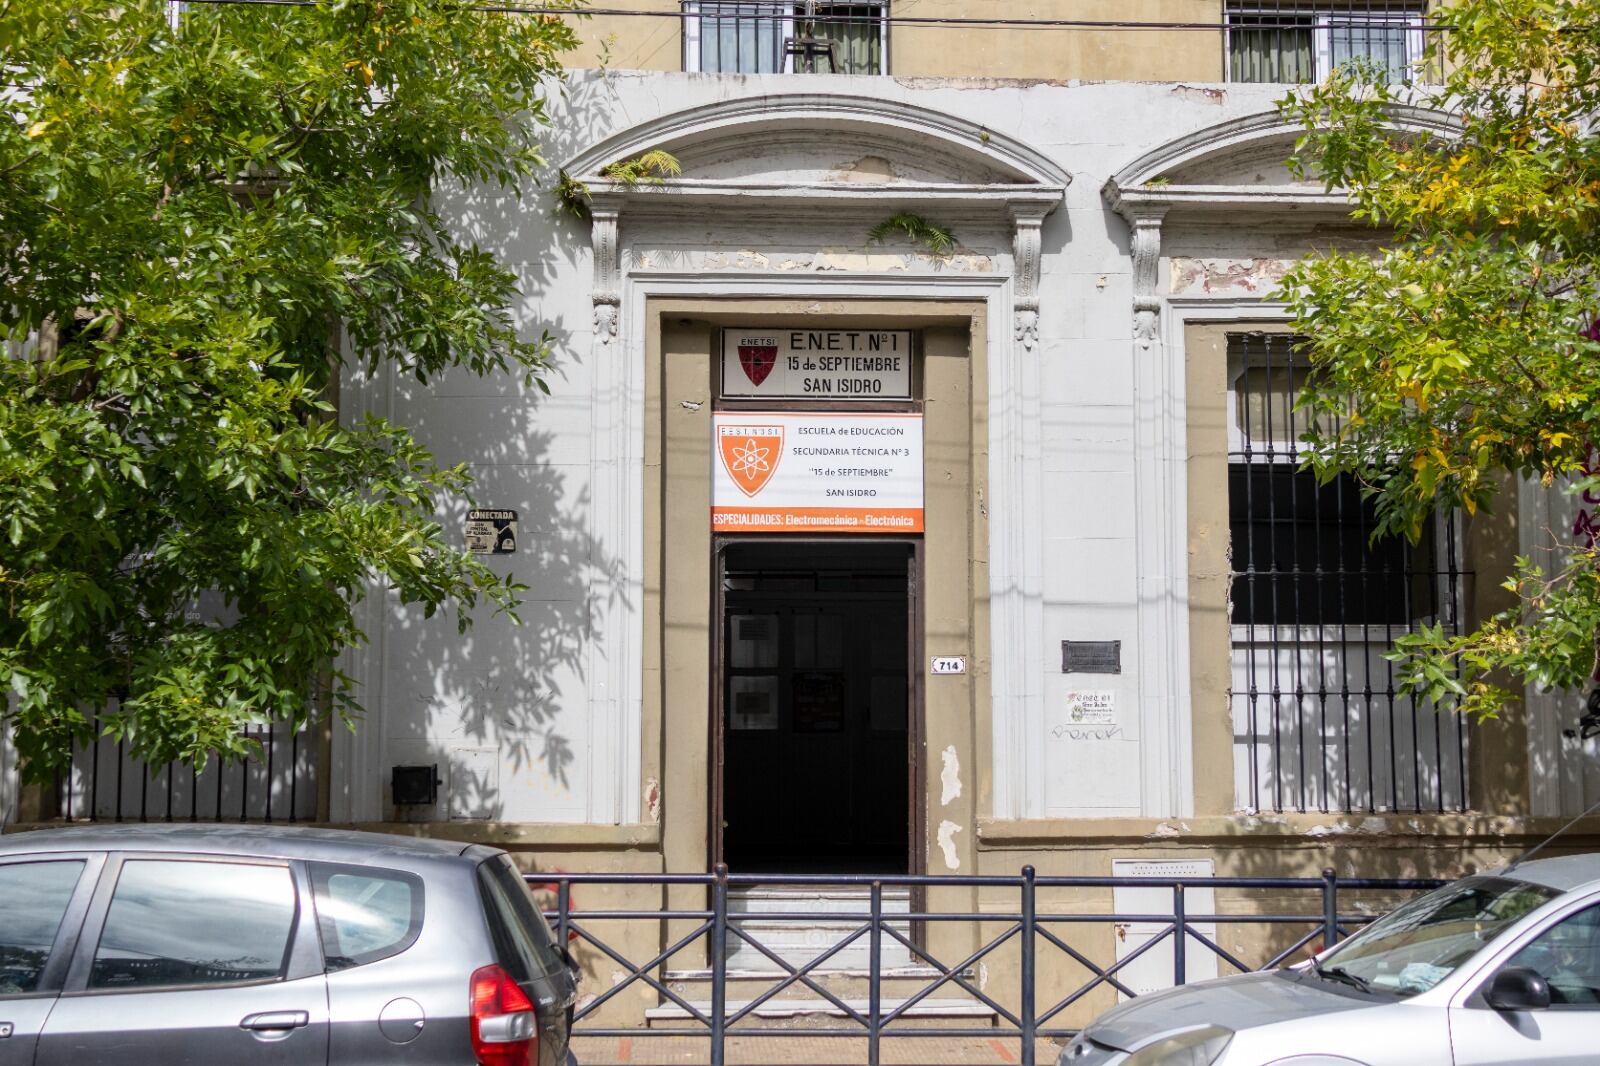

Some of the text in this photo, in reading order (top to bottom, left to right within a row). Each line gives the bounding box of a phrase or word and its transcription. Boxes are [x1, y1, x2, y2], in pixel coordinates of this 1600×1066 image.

[787, 356, 901, 372] 15 de SEPTIEMBRE
[803, 378, 882, 394] SAN ISIDRO
[798, 426, 904, 436] ESCUELA de EDUCACIÓN
[792, 447, 849, 456] SECUNDARIA
[851, 446, 889, 456] TÉCNICA
[904, 448, 910, 457] 3
[825, 467, 836, 476] de
[826, 488, 877, 497] SAN ISIDRO
[469, 511, 514, 519] CONECTADA
[713, 513, 784, 525] ESPECIALIDADES:
[785, 513, 858, 526] Electromecánica
[865, 514, 914, 526] Electrónica
[939, 661, 959, 671] 714
